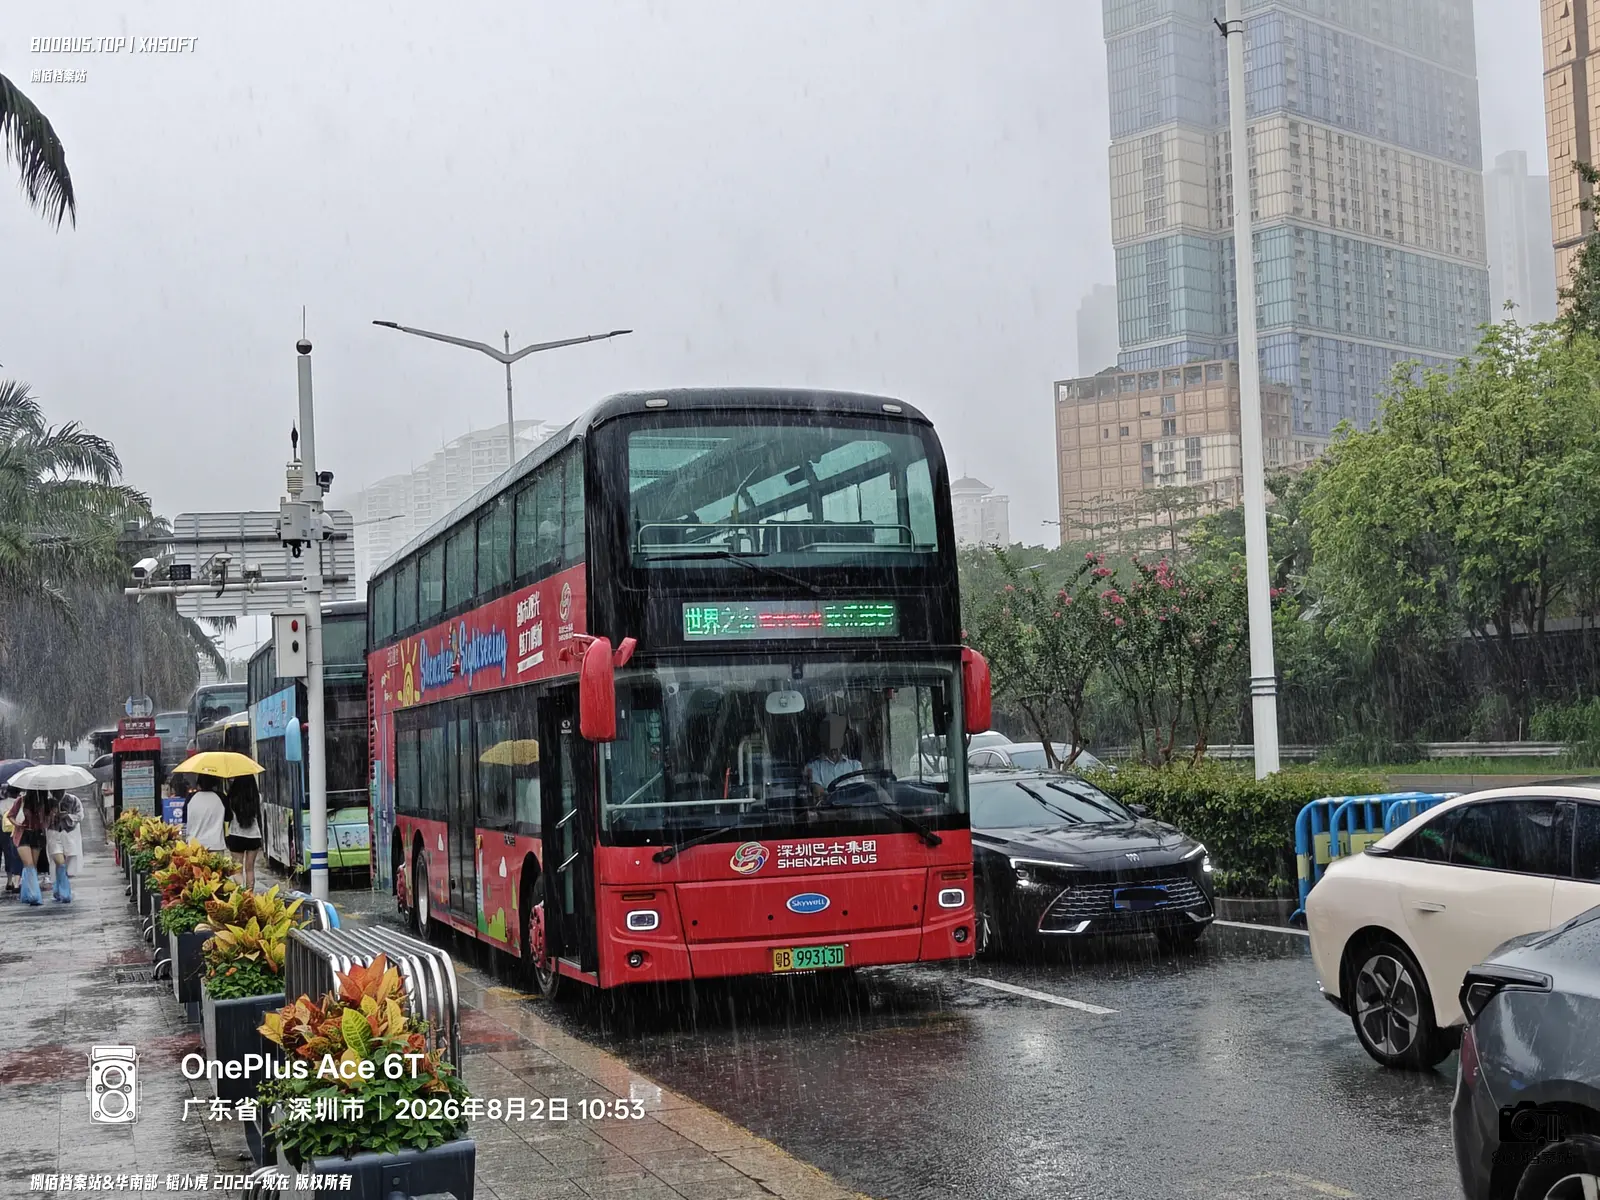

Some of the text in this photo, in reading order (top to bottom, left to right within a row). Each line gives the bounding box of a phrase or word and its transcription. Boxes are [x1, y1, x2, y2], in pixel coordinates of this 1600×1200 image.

[777, 840, 876, 857] 深圳巴士集团
[777, 854, 877, 869] SHENZHEN BUS
[796, 947, 844, 967] 99313D
